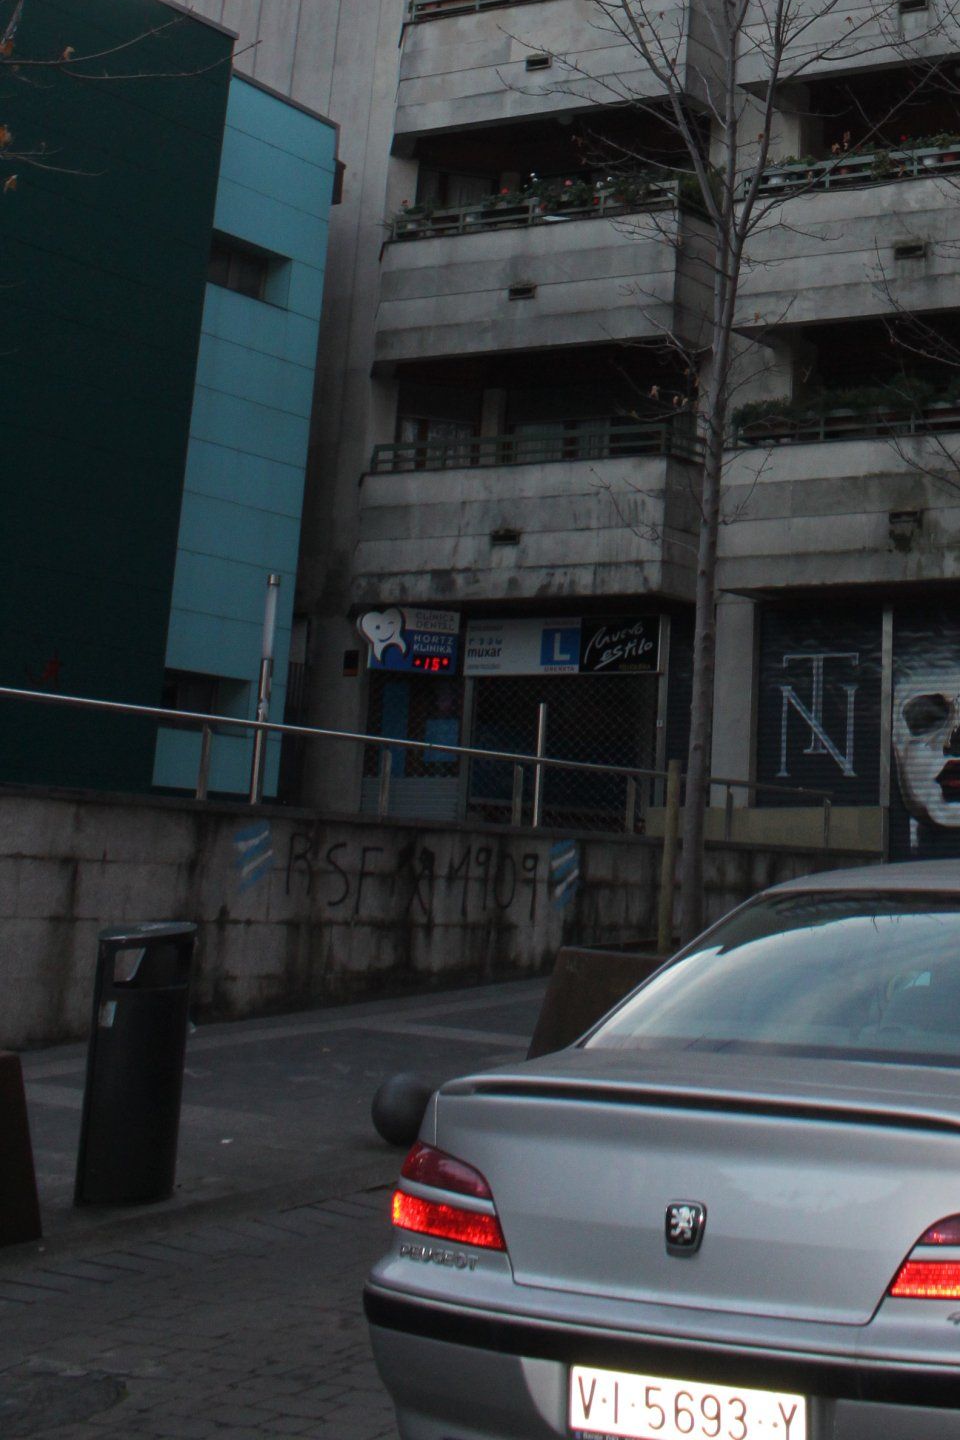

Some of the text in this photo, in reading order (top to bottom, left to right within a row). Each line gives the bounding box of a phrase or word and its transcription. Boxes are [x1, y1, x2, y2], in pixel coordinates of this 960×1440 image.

[413, 634, 454, 645] HORTZ
[413, 643, 454, 654] KLINIKA
[552, 631, 571, 661] L
[400, 1243, 479, 1271] PEUGEOT
[643, 1385, 748, 1440] 5693
